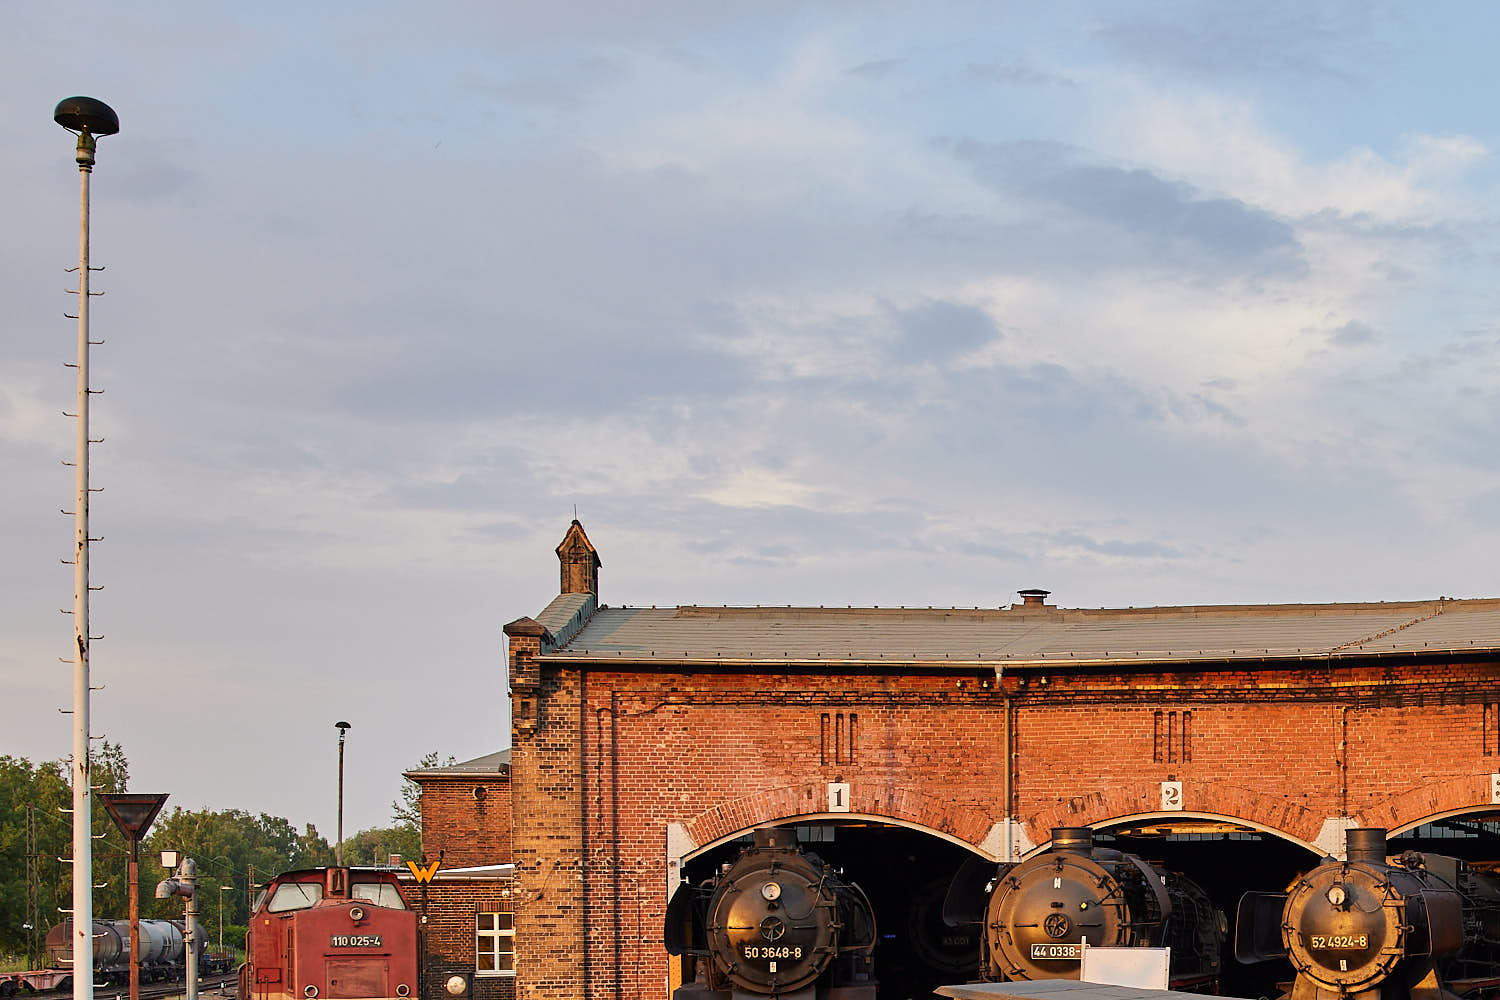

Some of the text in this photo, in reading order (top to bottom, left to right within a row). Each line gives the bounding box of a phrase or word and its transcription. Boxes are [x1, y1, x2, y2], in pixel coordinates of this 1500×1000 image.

[833, 788, 844, 807] 1
[1165, 787, 1178, 805] 2
[406, 861, 440, 884] W
[333, 936, 381, 946] 110 025-4
[1312, 935, 1367, 948] 52 4924-8
[744, 946, 802, 958] 50 3648-8
[1034, 946, 1081, 957] 44 0338-
